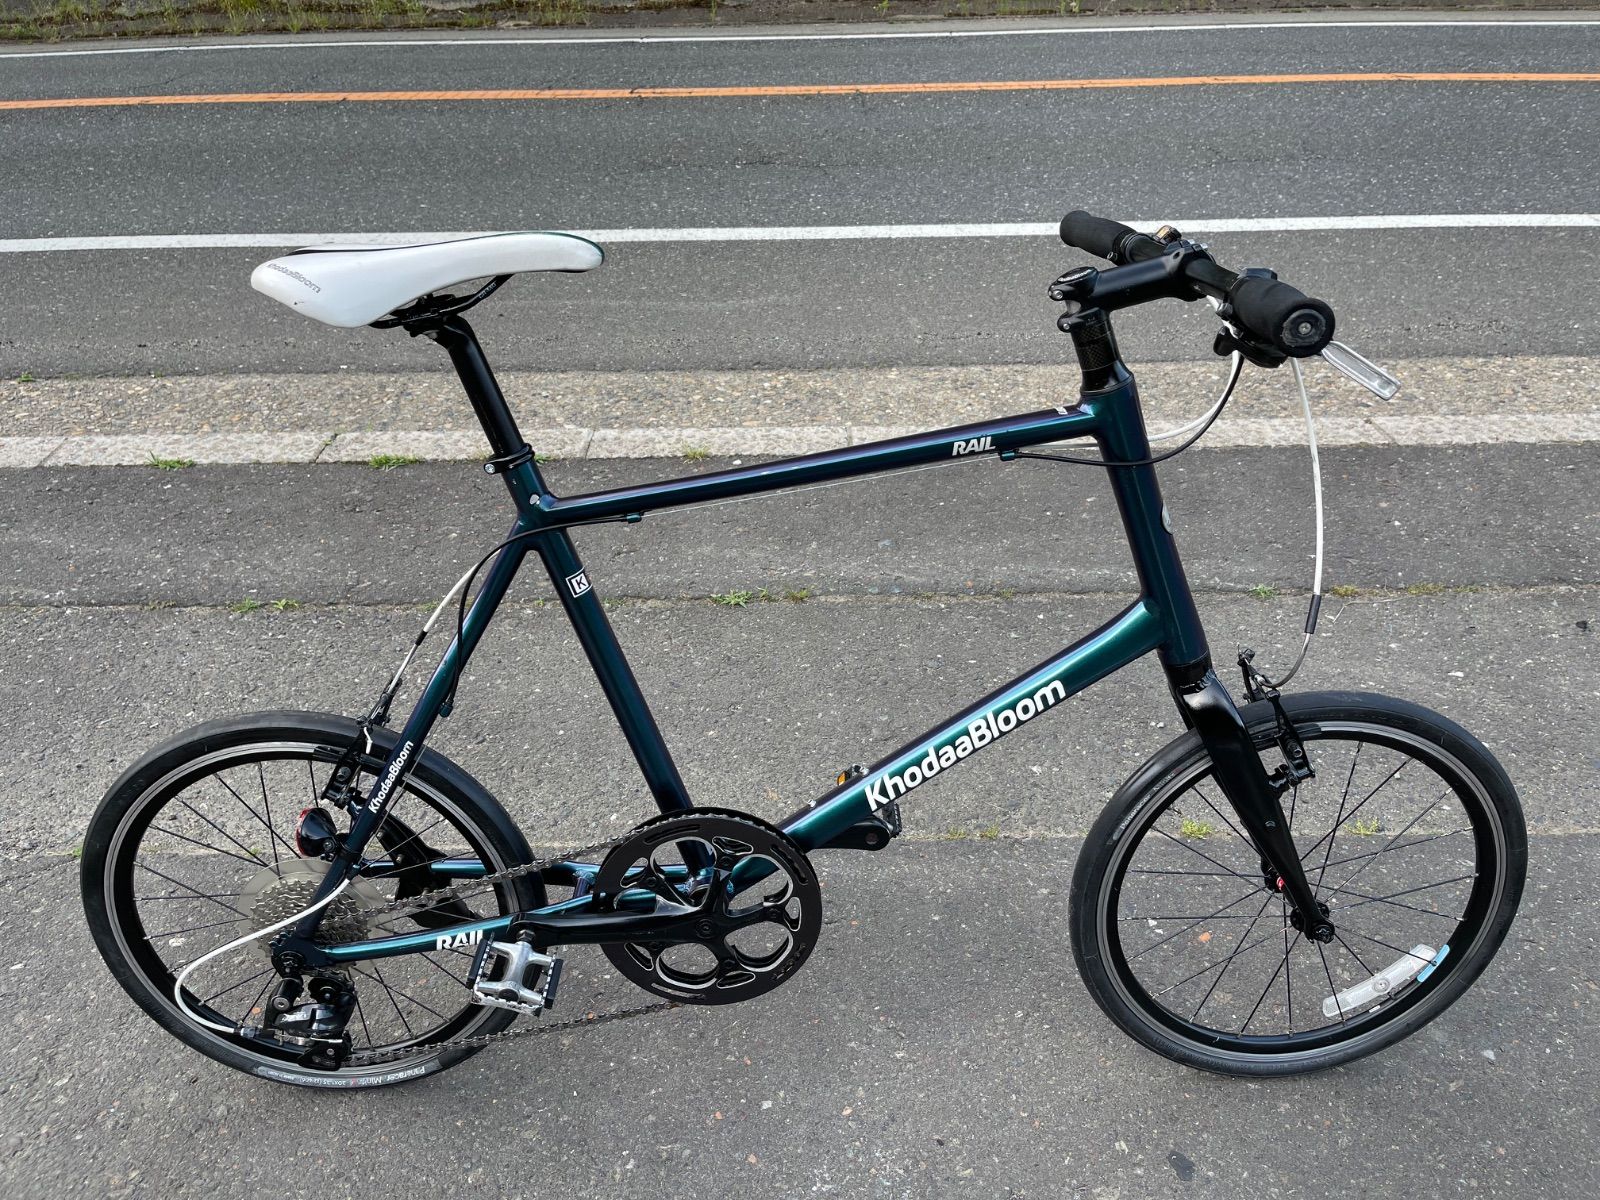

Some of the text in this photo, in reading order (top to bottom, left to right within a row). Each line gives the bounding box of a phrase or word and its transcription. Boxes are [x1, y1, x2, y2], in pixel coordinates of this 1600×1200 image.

[952, 436, 996, 456] RAIL
[368, 740, 414, 813] KhodaaBloom
[864, 679, 1066, 812] KhodaaBloom
